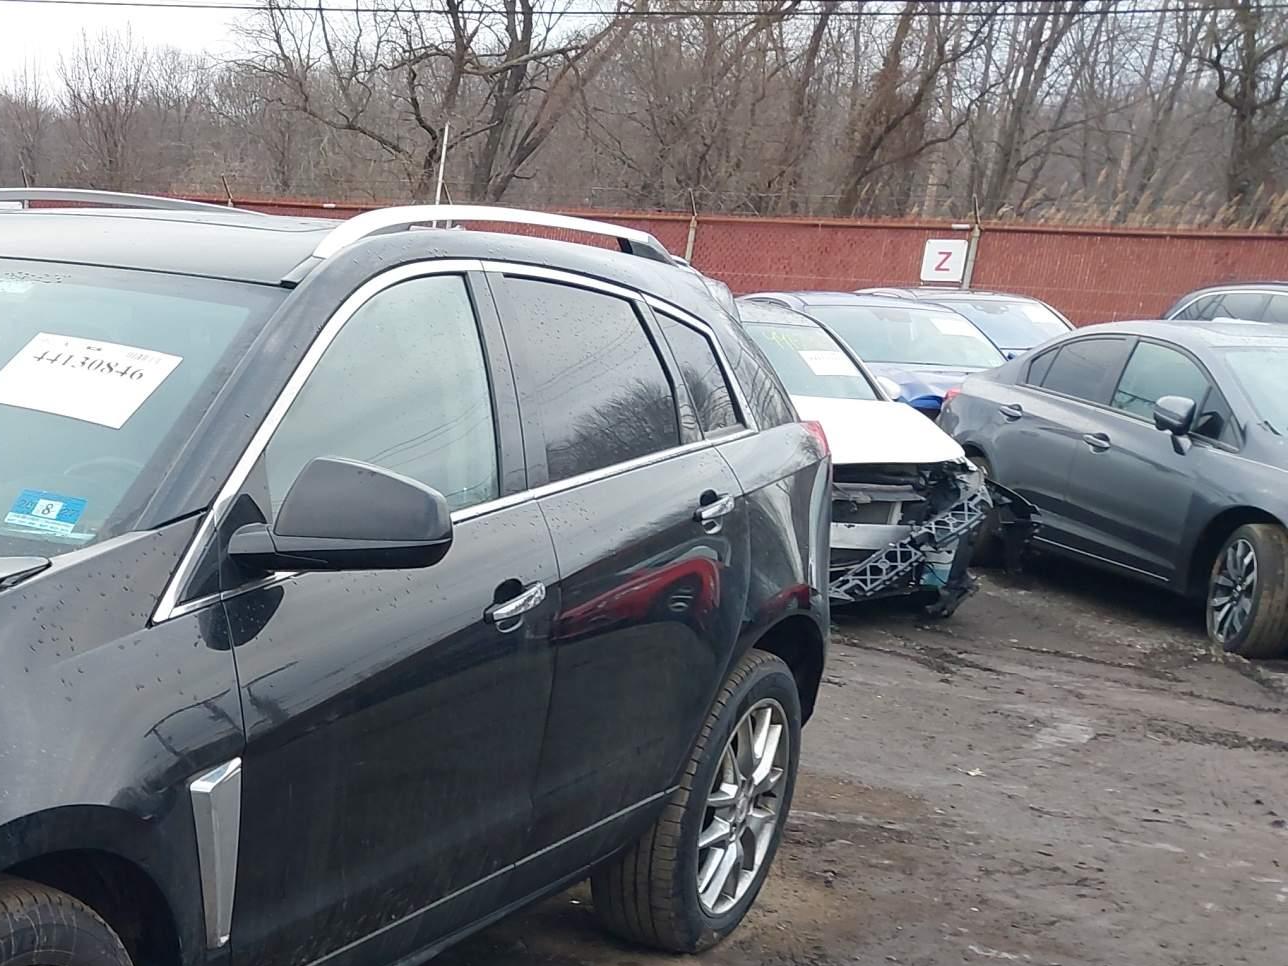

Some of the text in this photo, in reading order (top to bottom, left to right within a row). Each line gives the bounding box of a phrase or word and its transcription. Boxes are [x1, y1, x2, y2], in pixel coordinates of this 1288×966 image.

[934, 251, 953, 271] Z
[32, 350, 144, 381] 44130846
[41, 503, 54, 515] 8
